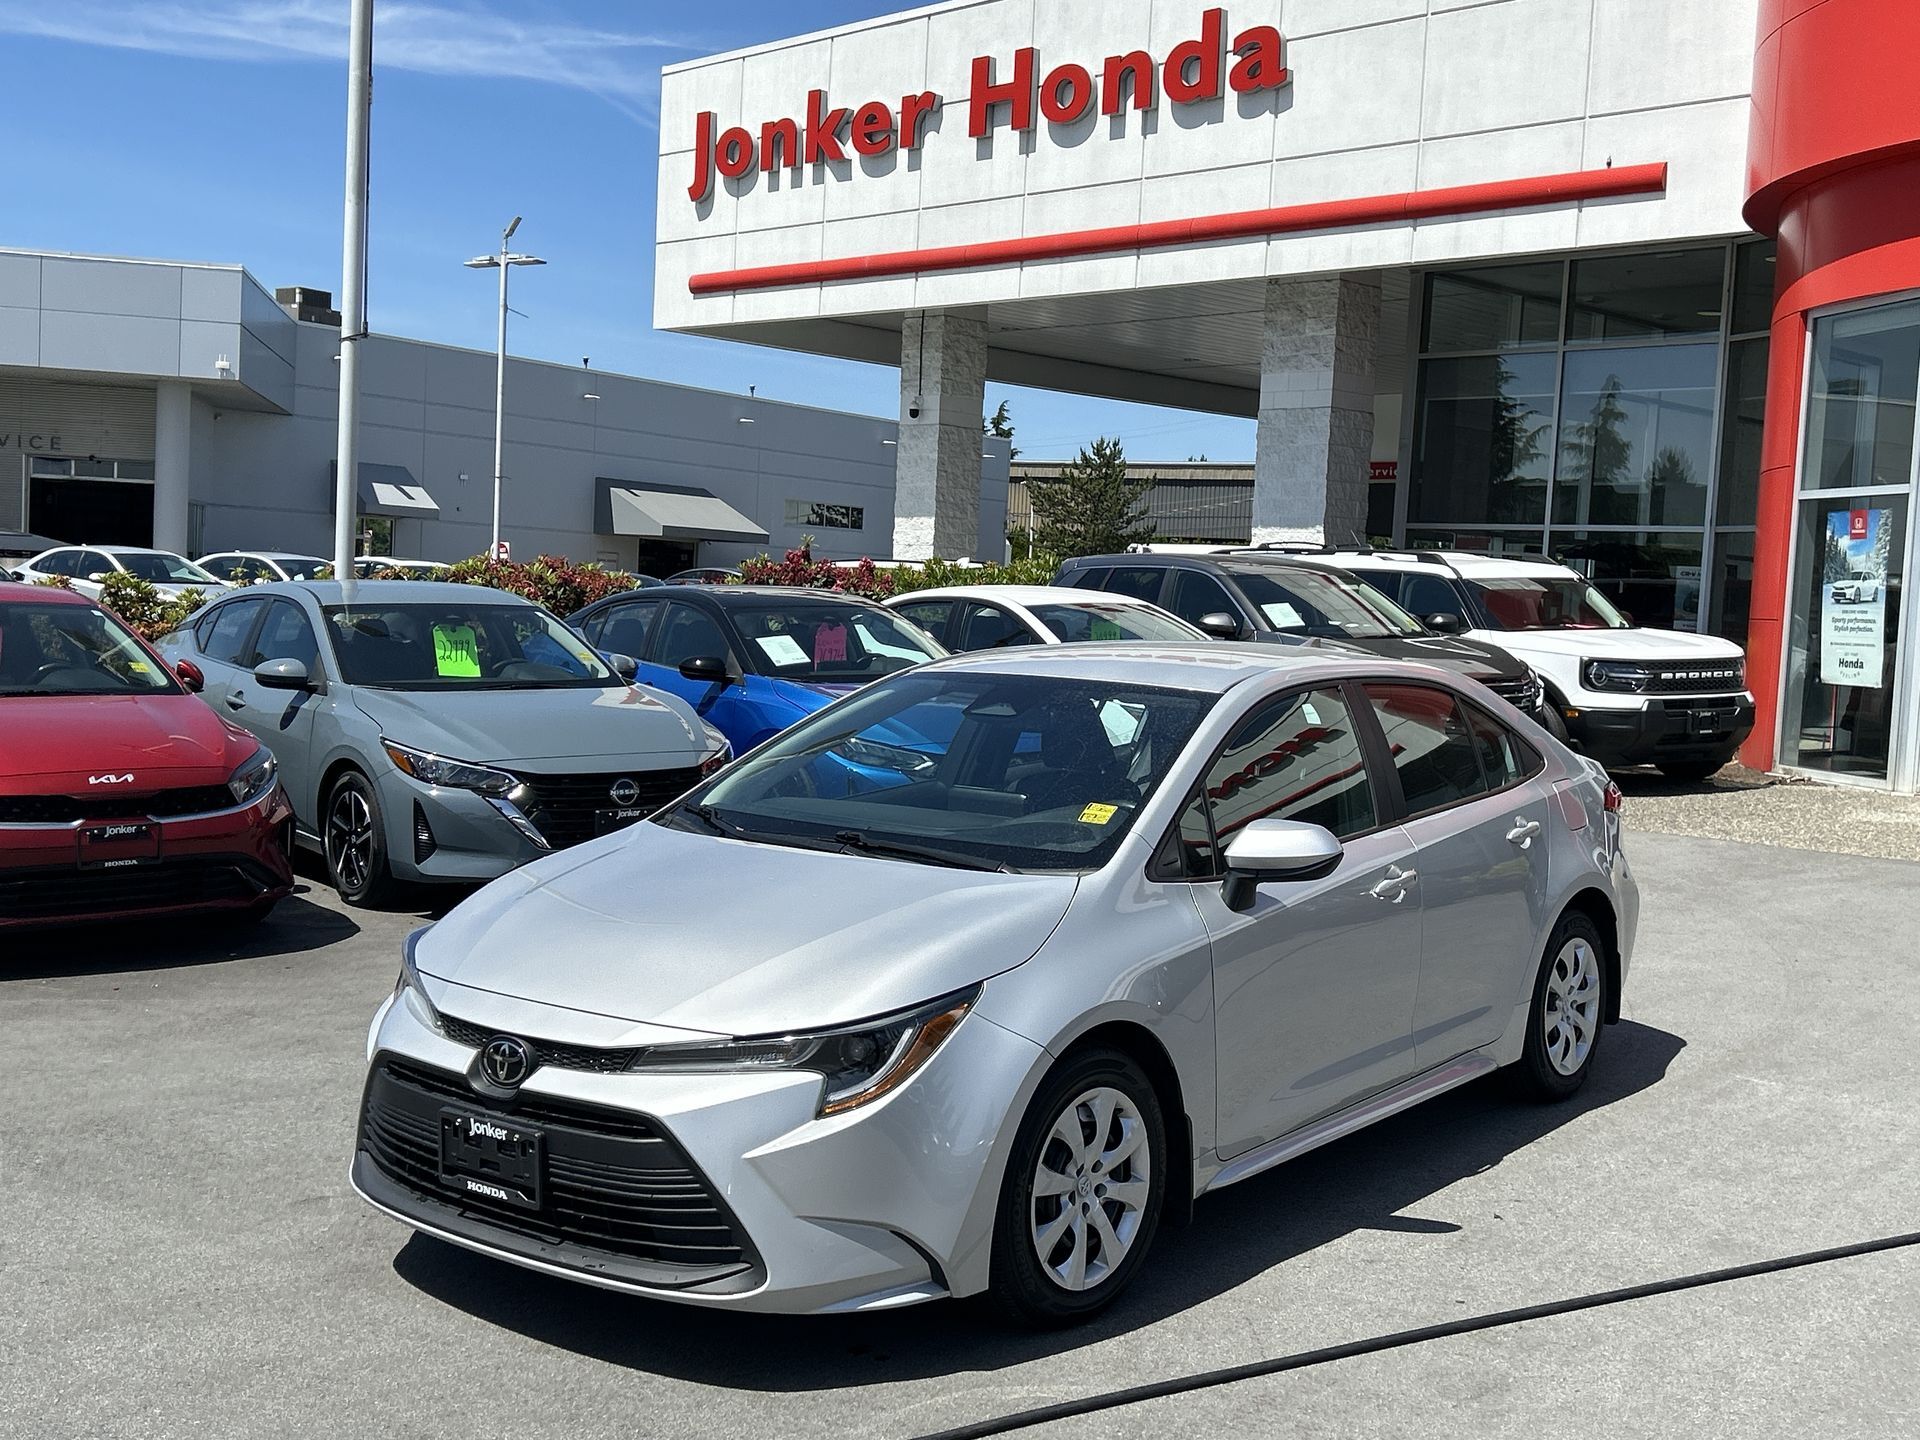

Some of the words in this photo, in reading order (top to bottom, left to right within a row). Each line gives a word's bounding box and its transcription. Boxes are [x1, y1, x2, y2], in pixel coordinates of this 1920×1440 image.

[688, 90, 942, 202] Jonker
[969, 8, 1292, 138] Honda
[1838, 658, 1864, 669] Honda
[1661, 671, 1733, 679] BRONCO
[88, 773, 134, 784] KIA
[610, 787, 640, 796] NISSAN
[616, 809, 641, 820] Jonker
[104, 825, 138, 838] Jonker
[104, 859, 138, 867] HONDA
[469, 1117, 508, 1141] Jonker
[467, 1180, 508, 1200] HONDA
